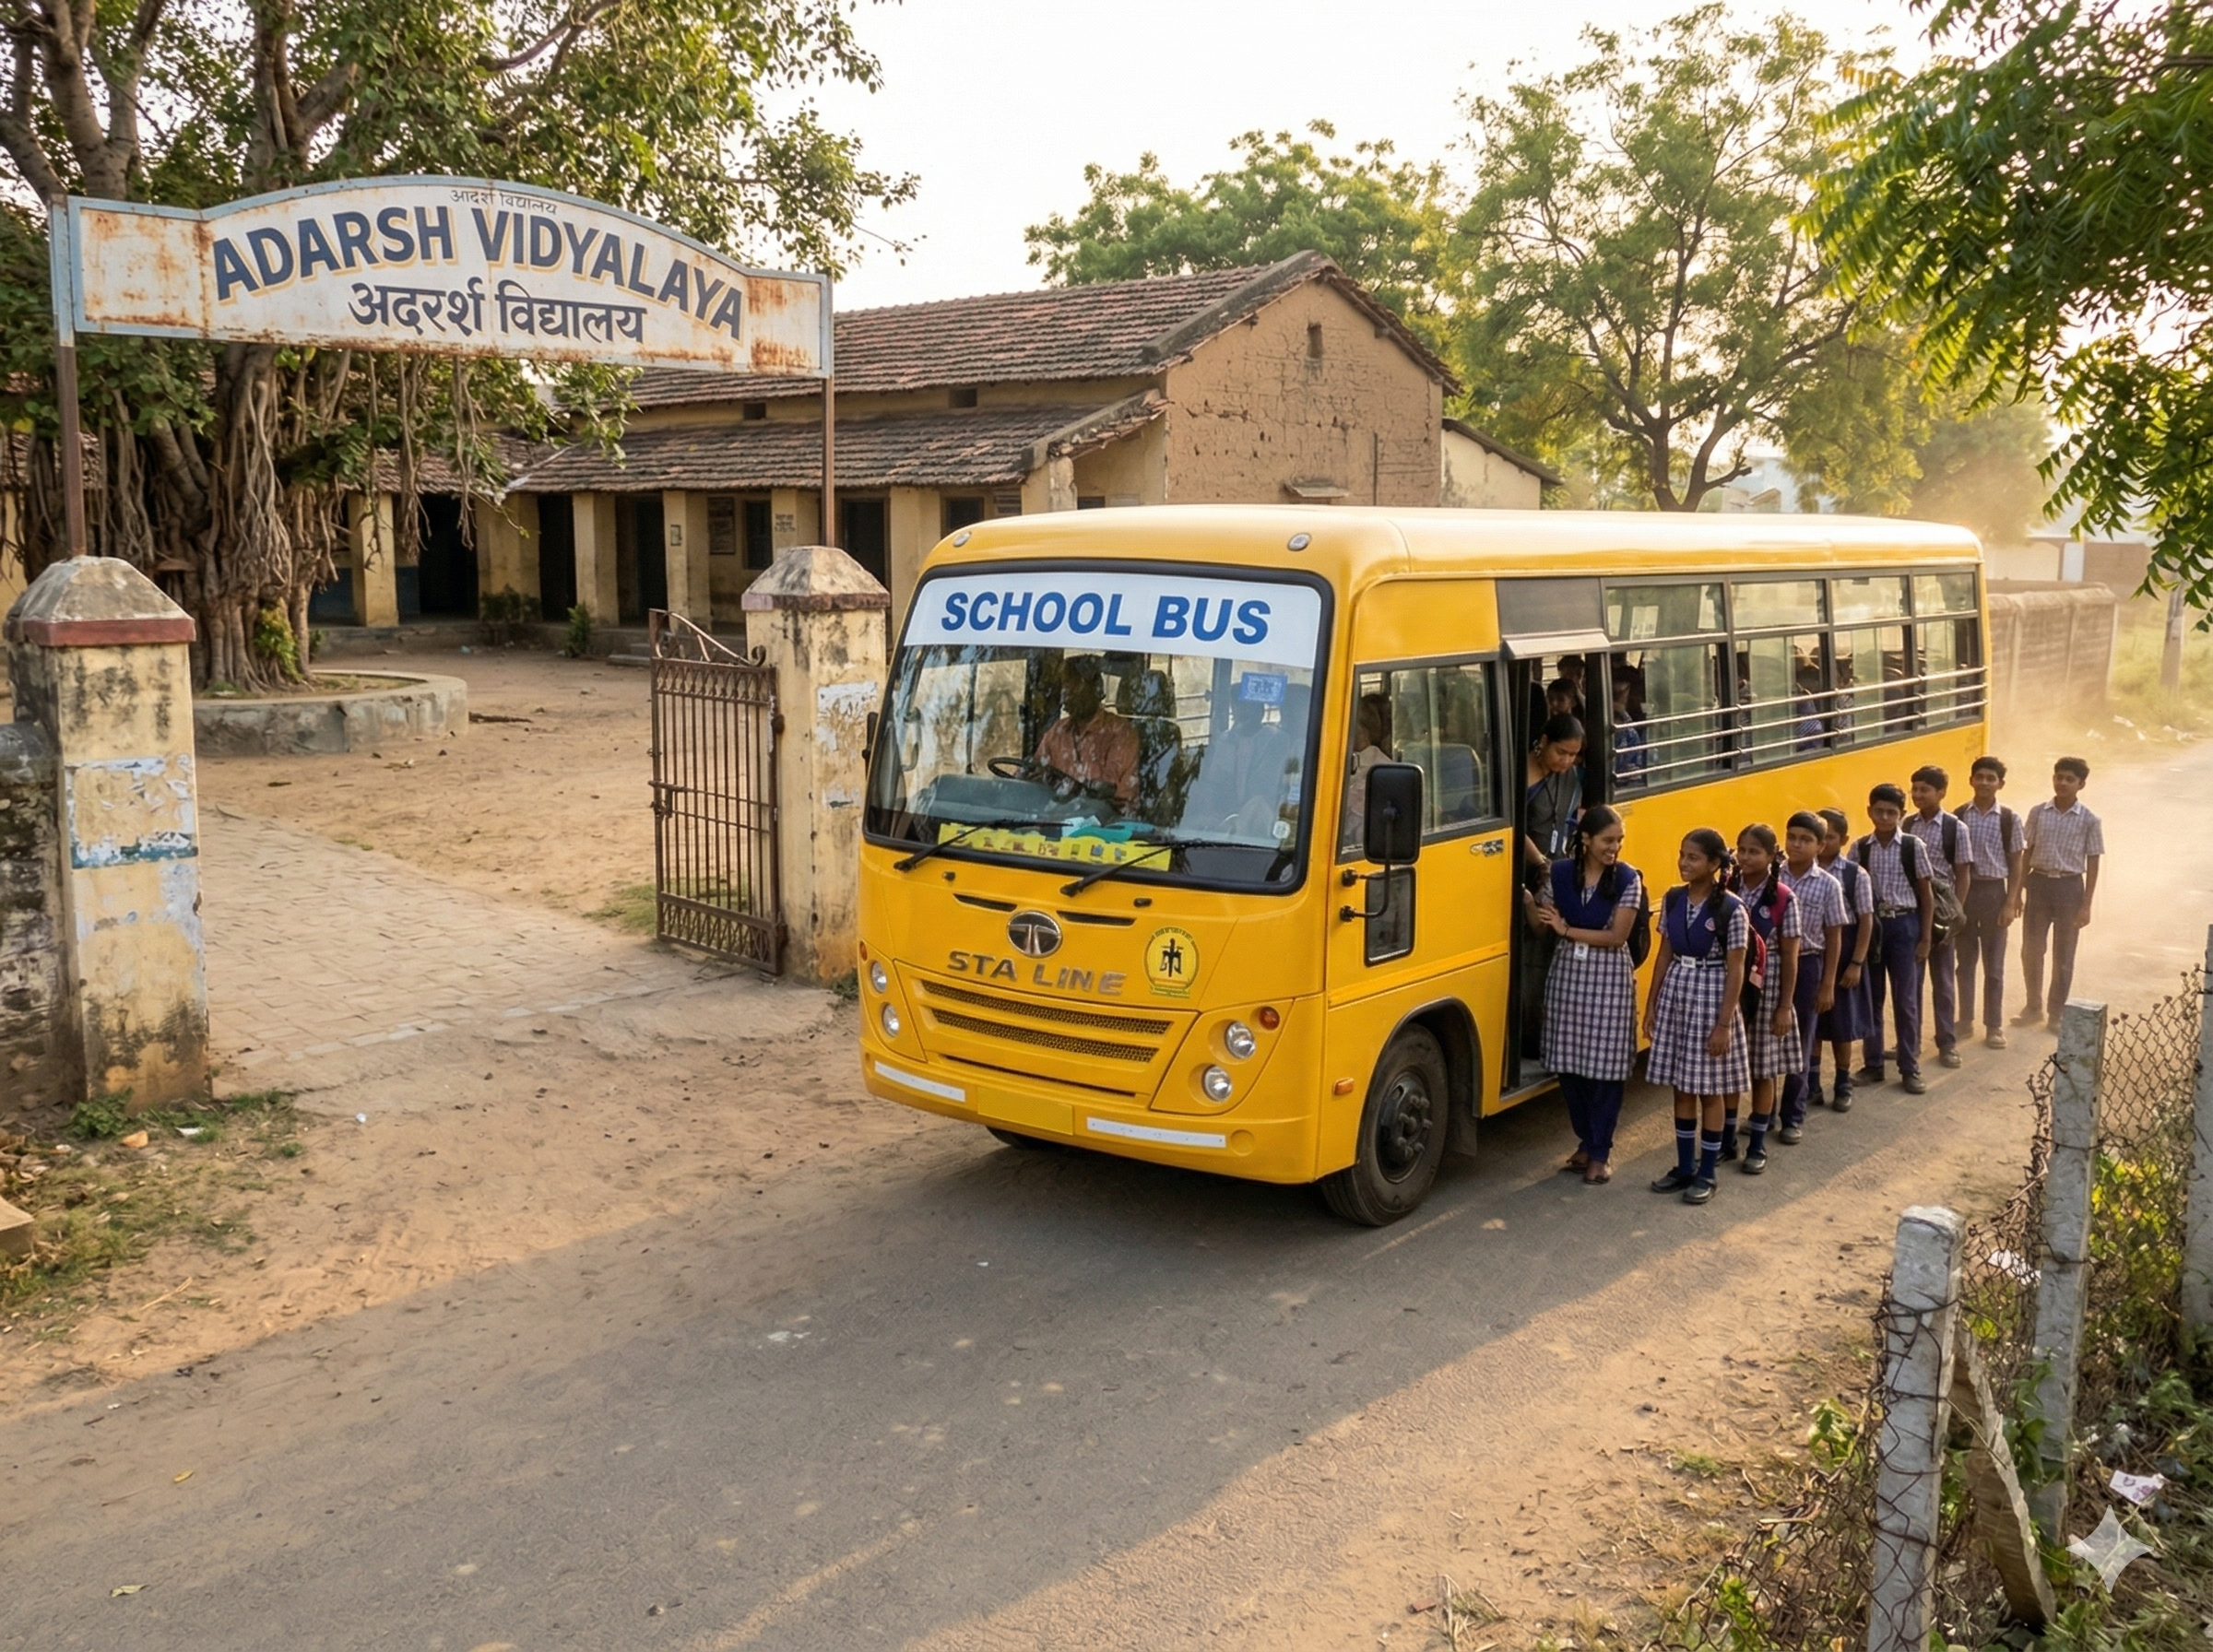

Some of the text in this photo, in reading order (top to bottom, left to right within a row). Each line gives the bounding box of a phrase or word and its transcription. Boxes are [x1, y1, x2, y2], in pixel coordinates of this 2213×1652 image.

[213, 206, 743, 341] ADARSH VIDYALAYA
[495, 279, 647, 343] विद्यालय
[941, 591, 1271, 644] SCHOOL BUS
[947, 950, 1127, 996] STA LINE
